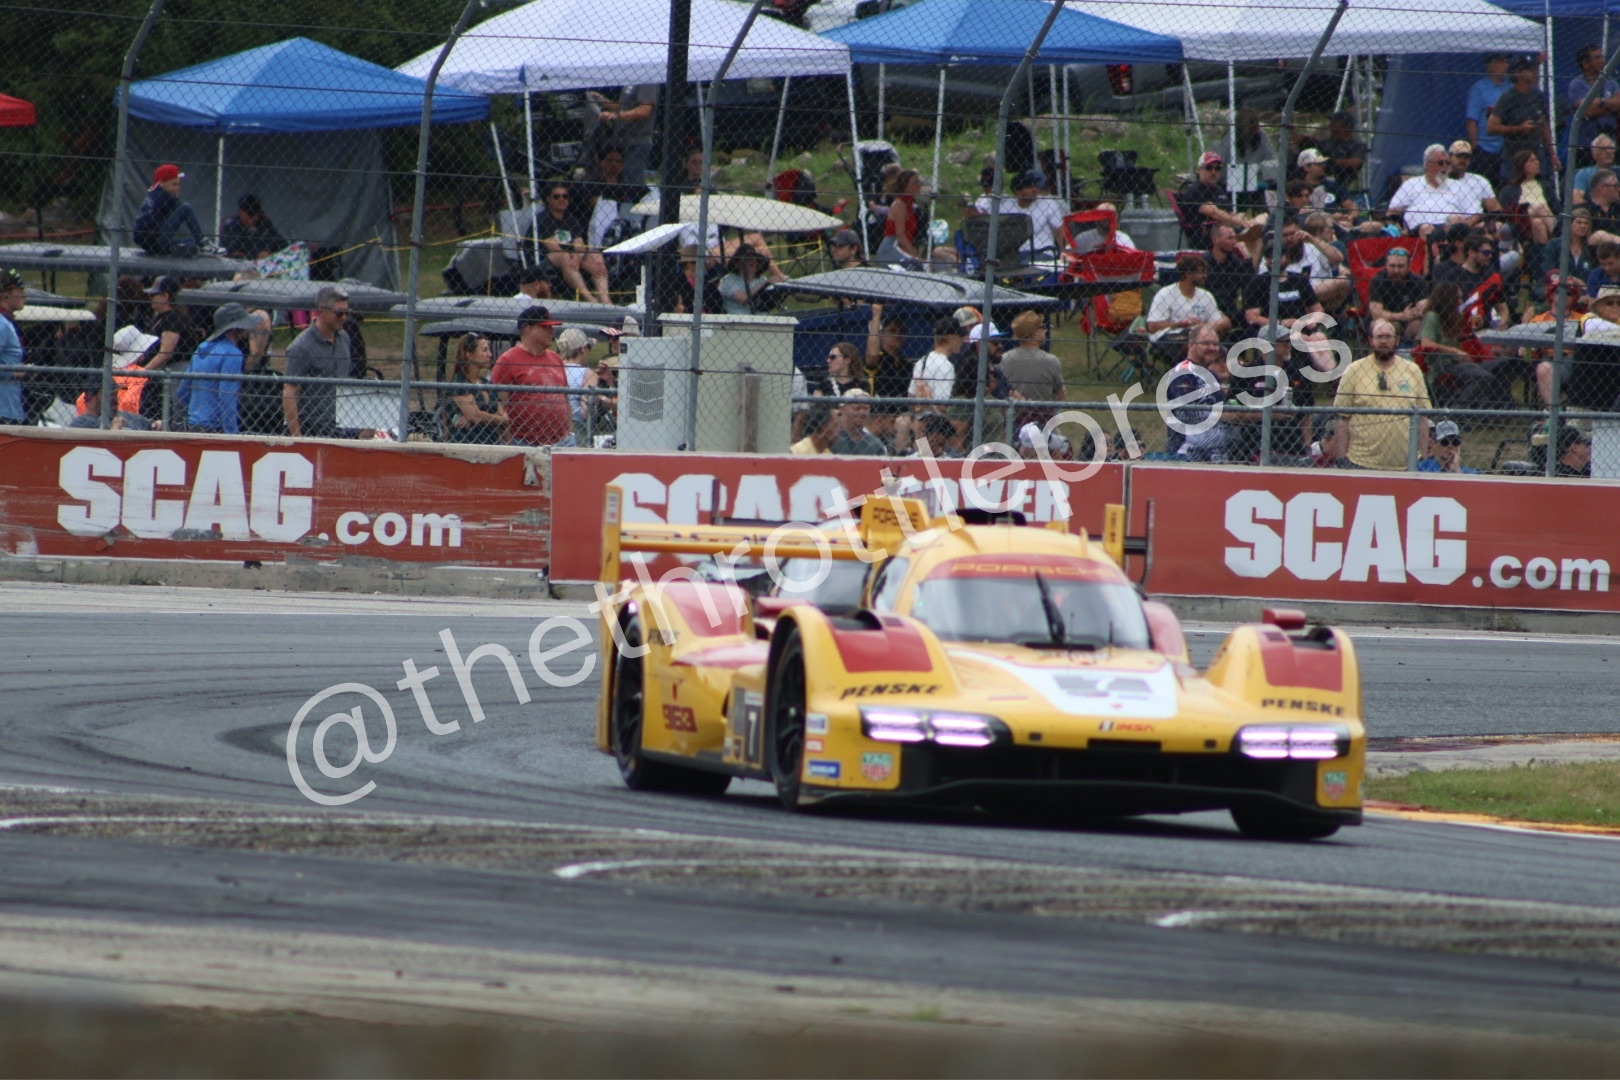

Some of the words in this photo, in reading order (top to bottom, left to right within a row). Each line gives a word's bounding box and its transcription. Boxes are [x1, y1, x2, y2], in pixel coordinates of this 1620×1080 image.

[58, 446, 462, 547] SCAG.com
[1224, 489, 1611, 592] SCAG.com
[839, 683, 942, 701] PENSKE
[1261, 698, 1345, 717] PENSKE
